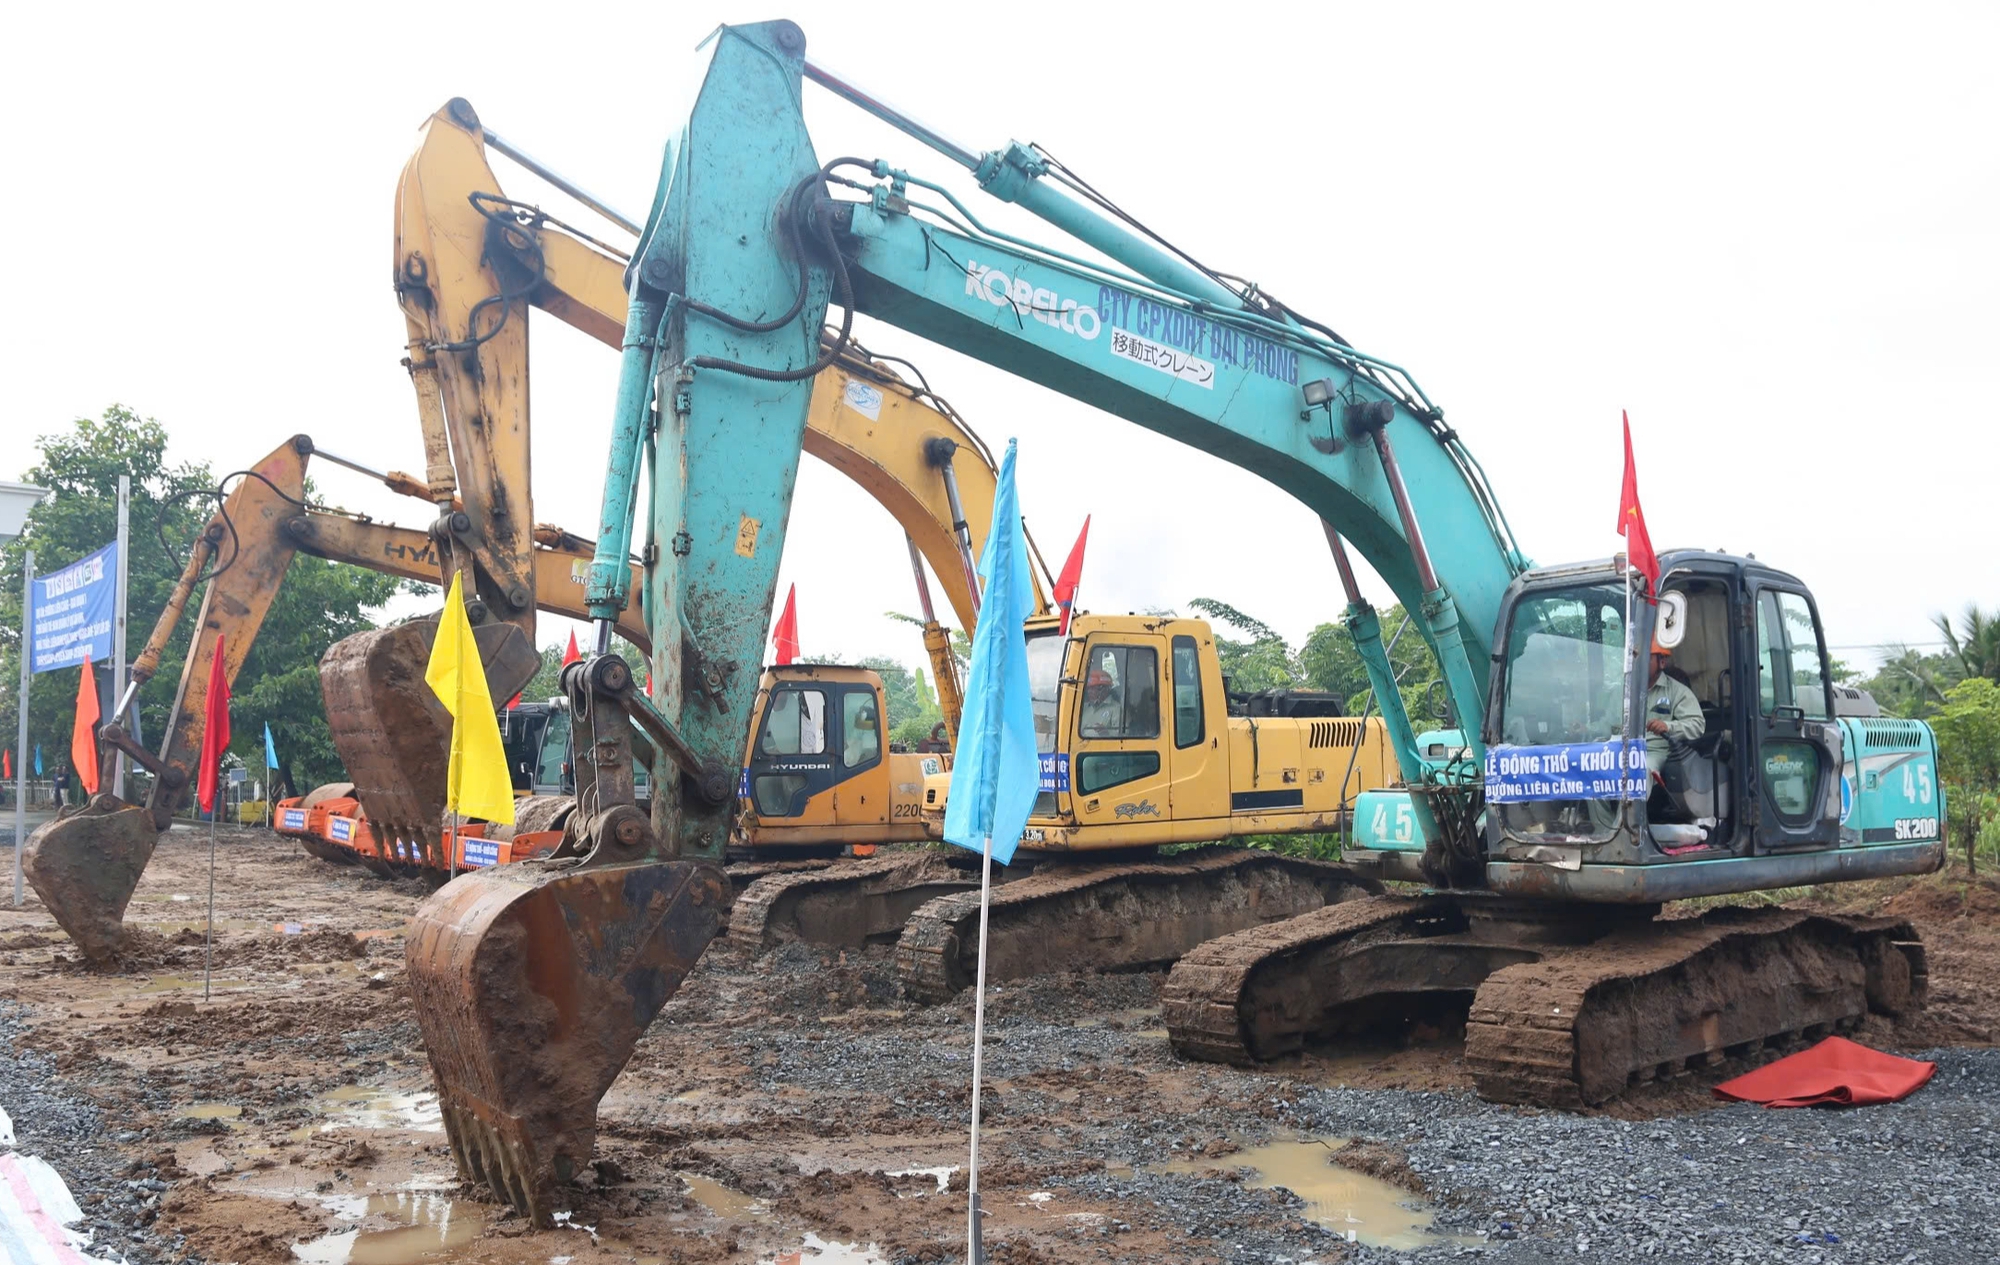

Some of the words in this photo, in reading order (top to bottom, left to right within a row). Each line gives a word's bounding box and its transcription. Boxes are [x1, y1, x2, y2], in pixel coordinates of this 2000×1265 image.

[965, 259, 1100, 341] KOBELCO
[1098, 285, 1130, 328] CTY
[1211, 323, 1242, 370] ĐẠI
[1244, 342, 1299, 387] PHONG
[1112, 331, 1214, 384] 移動式クレーン
[1500, 754, 1540, 779] ĐỘNG
[1580, 746, 1615, 772] KHỞI
[1524, 780, 1550, 796] LIÊN
[1592, 780, 1616, 793] GIAI
[1902, 764, 1932, 804] 45
[1371, 803, 1413, 842] 45
[1894, 817, 1938, 840] SK200
